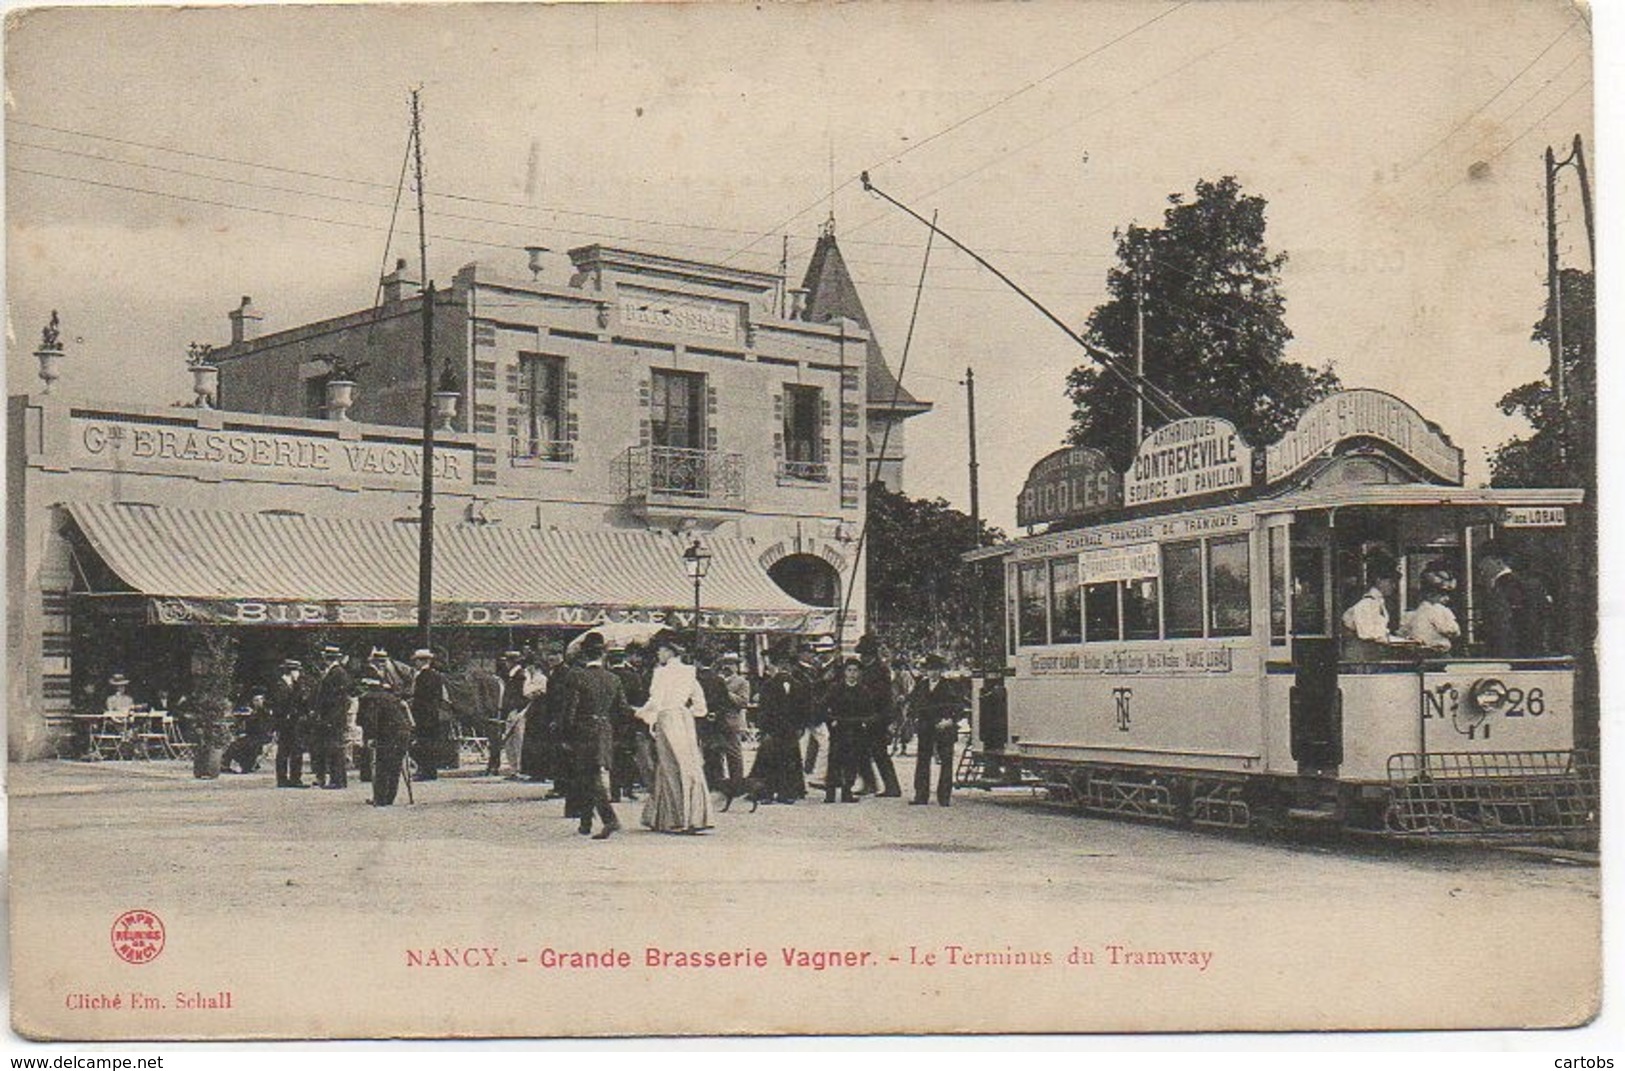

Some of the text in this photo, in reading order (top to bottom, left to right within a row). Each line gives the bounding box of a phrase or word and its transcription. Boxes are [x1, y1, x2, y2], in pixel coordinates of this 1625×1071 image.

[1153, 419, 1216, 447] ARTHRITIQUES
[132, 428, 331, 470] BRASSERIE
[1129, 465, 1243, 503] SOURCE DU PAVILLON
[1184, 514, 1239, 532] TRAMWAYS
[1529, 509, 1563, 523] LOBAU
[236, 602, 782, 631] BIERES DE MAXEVILLE
[1505, 687, 1546, 717] 26
